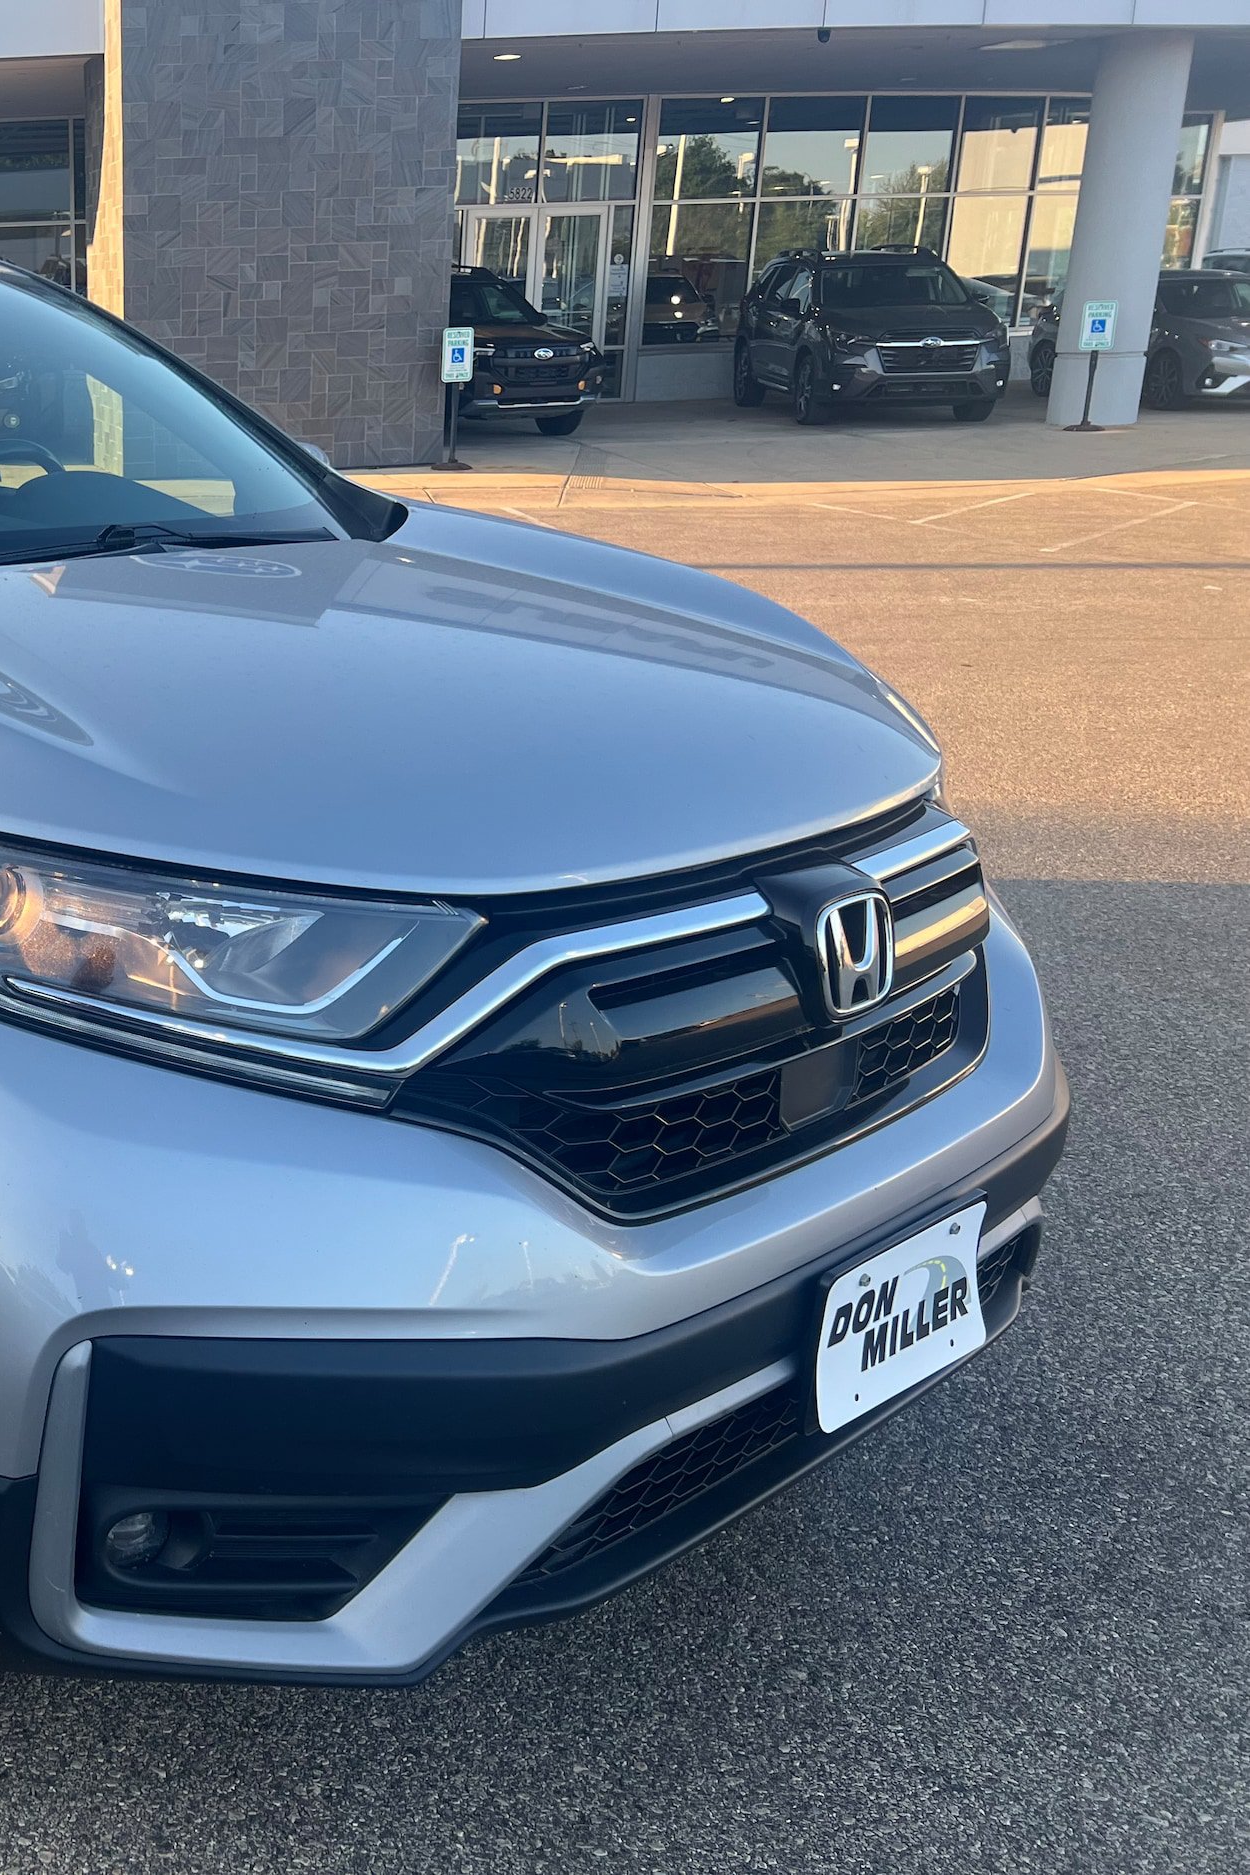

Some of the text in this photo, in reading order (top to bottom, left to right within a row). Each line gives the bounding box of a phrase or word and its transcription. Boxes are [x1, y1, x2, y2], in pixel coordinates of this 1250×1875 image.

[508, 187, 532, 199] 5822
[447, 339, 469, 347] PARKING
[827, 1275, 899, 1349] DON
[861, 1276, 969, 1372] MILLER
